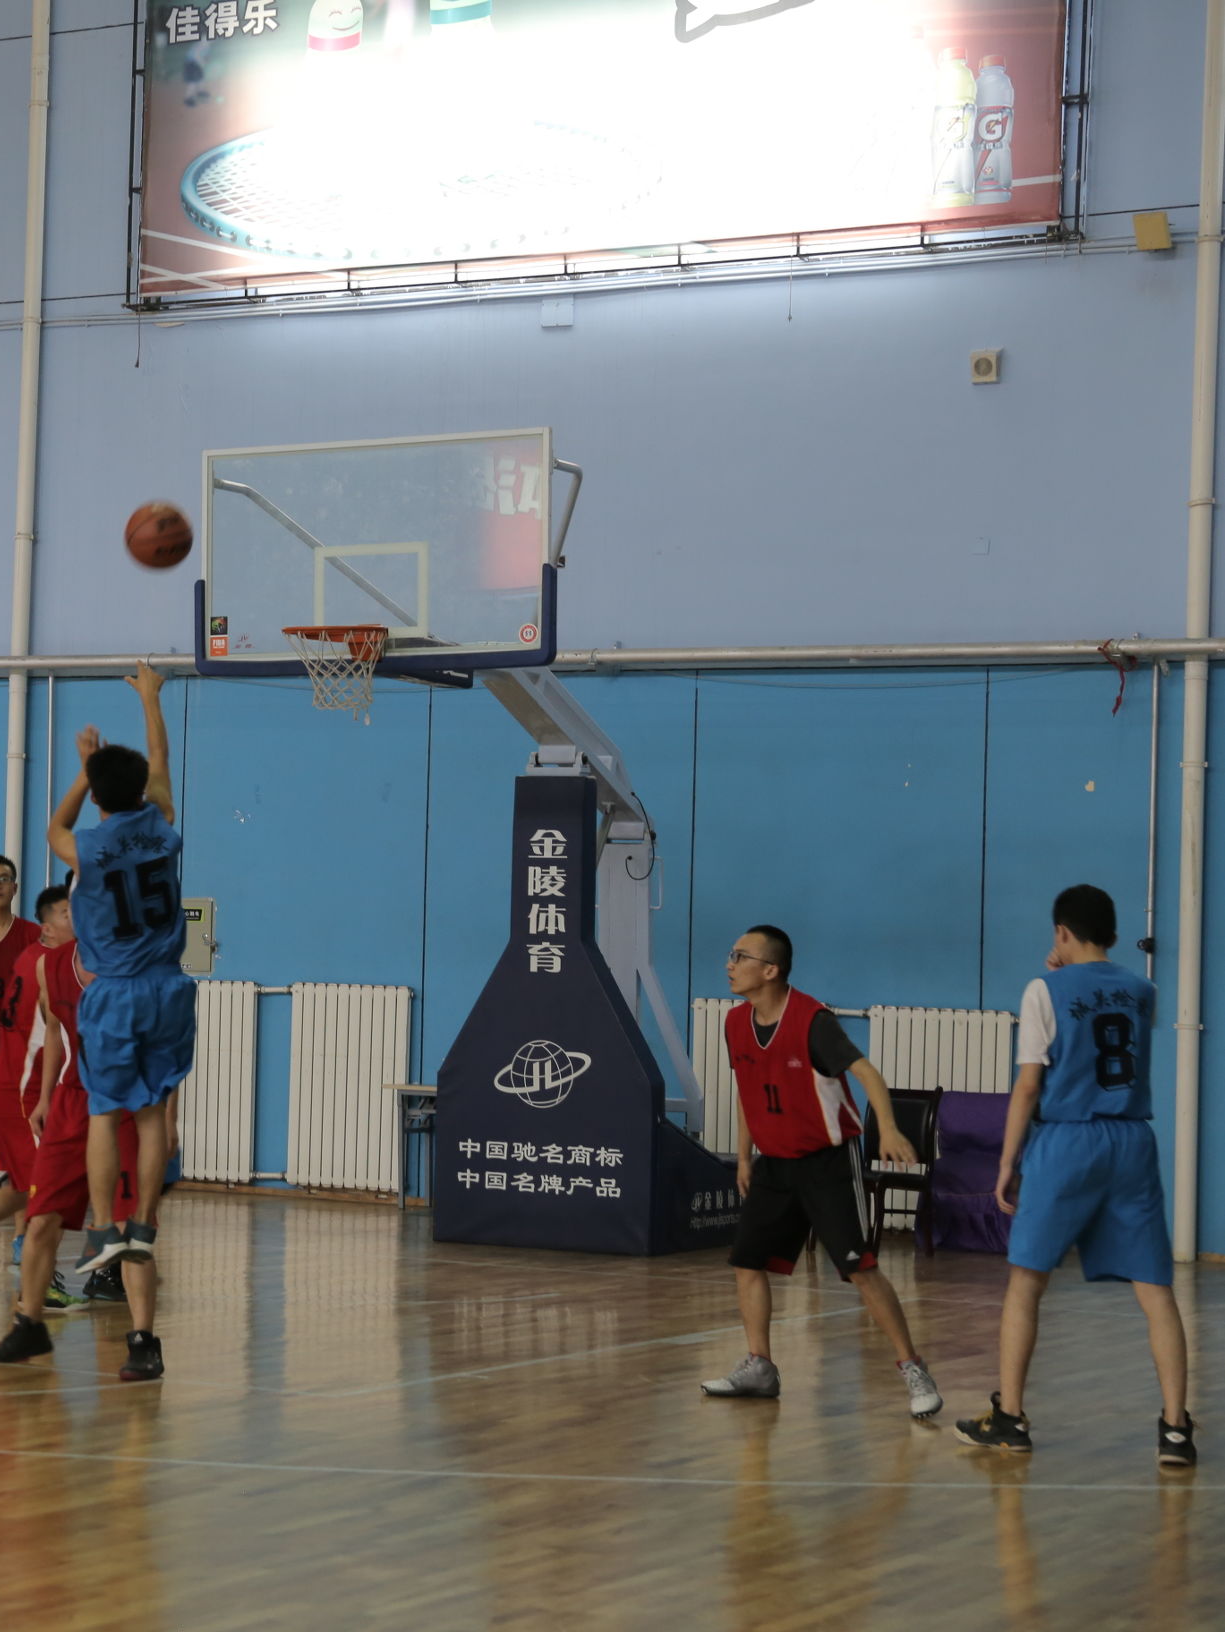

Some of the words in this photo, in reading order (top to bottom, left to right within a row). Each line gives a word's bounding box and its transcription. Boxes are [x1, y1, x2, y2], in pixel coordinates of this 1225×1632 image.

[165, 0, 280, 44] 佳得乐
[103, 856, 174, 940] 15
[526, 829, 568, 973] 金陵体育
[1093, 1013, 1137, 1091] 8
[762, 1084, 784, 1115] 11
[458, 1138, 624, 1168] 中国驰名商标
[456, 1168, 621, 1198] 中国名牌产品
[704, 1189, 743, 1210] 金陵体
